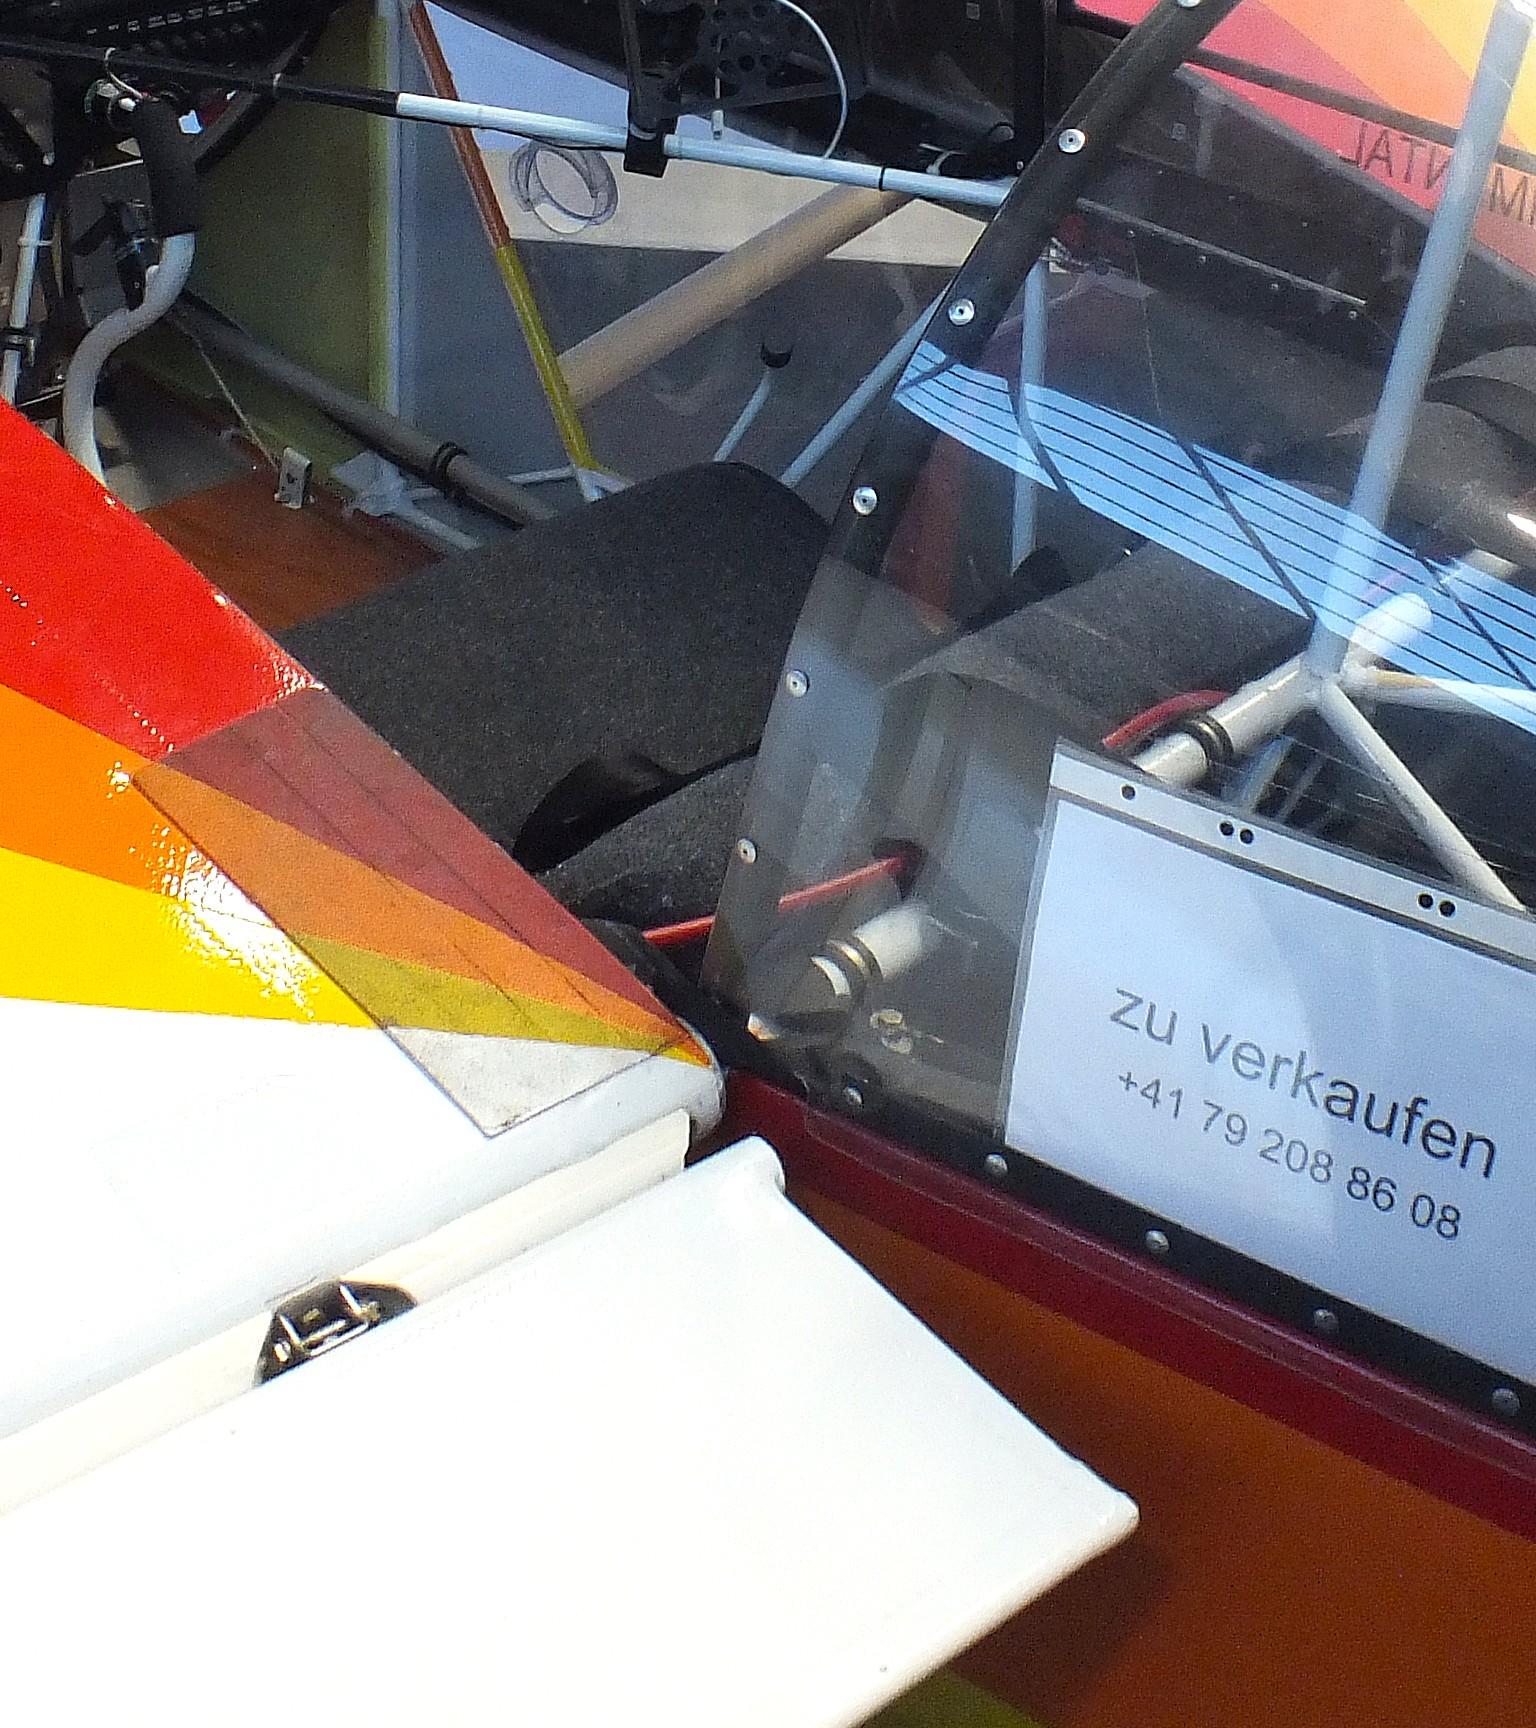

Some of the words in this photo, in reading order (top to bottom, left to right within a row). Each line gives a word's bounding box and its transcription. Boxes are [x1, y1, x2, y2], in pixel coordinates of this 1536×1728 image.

[1109, 986, 1179, 1046] zu
[1200, 1022, 1498, 1180] verkaufen
[1118, 1071, 1184, 1121] +41
[1202, 1098, 1249, 1147] 79
[1258, 1128, 1334, 1184] 208
[1346, 1166, 1398, 1213] 86
[1410, 1193, 1462, 1241] 08
